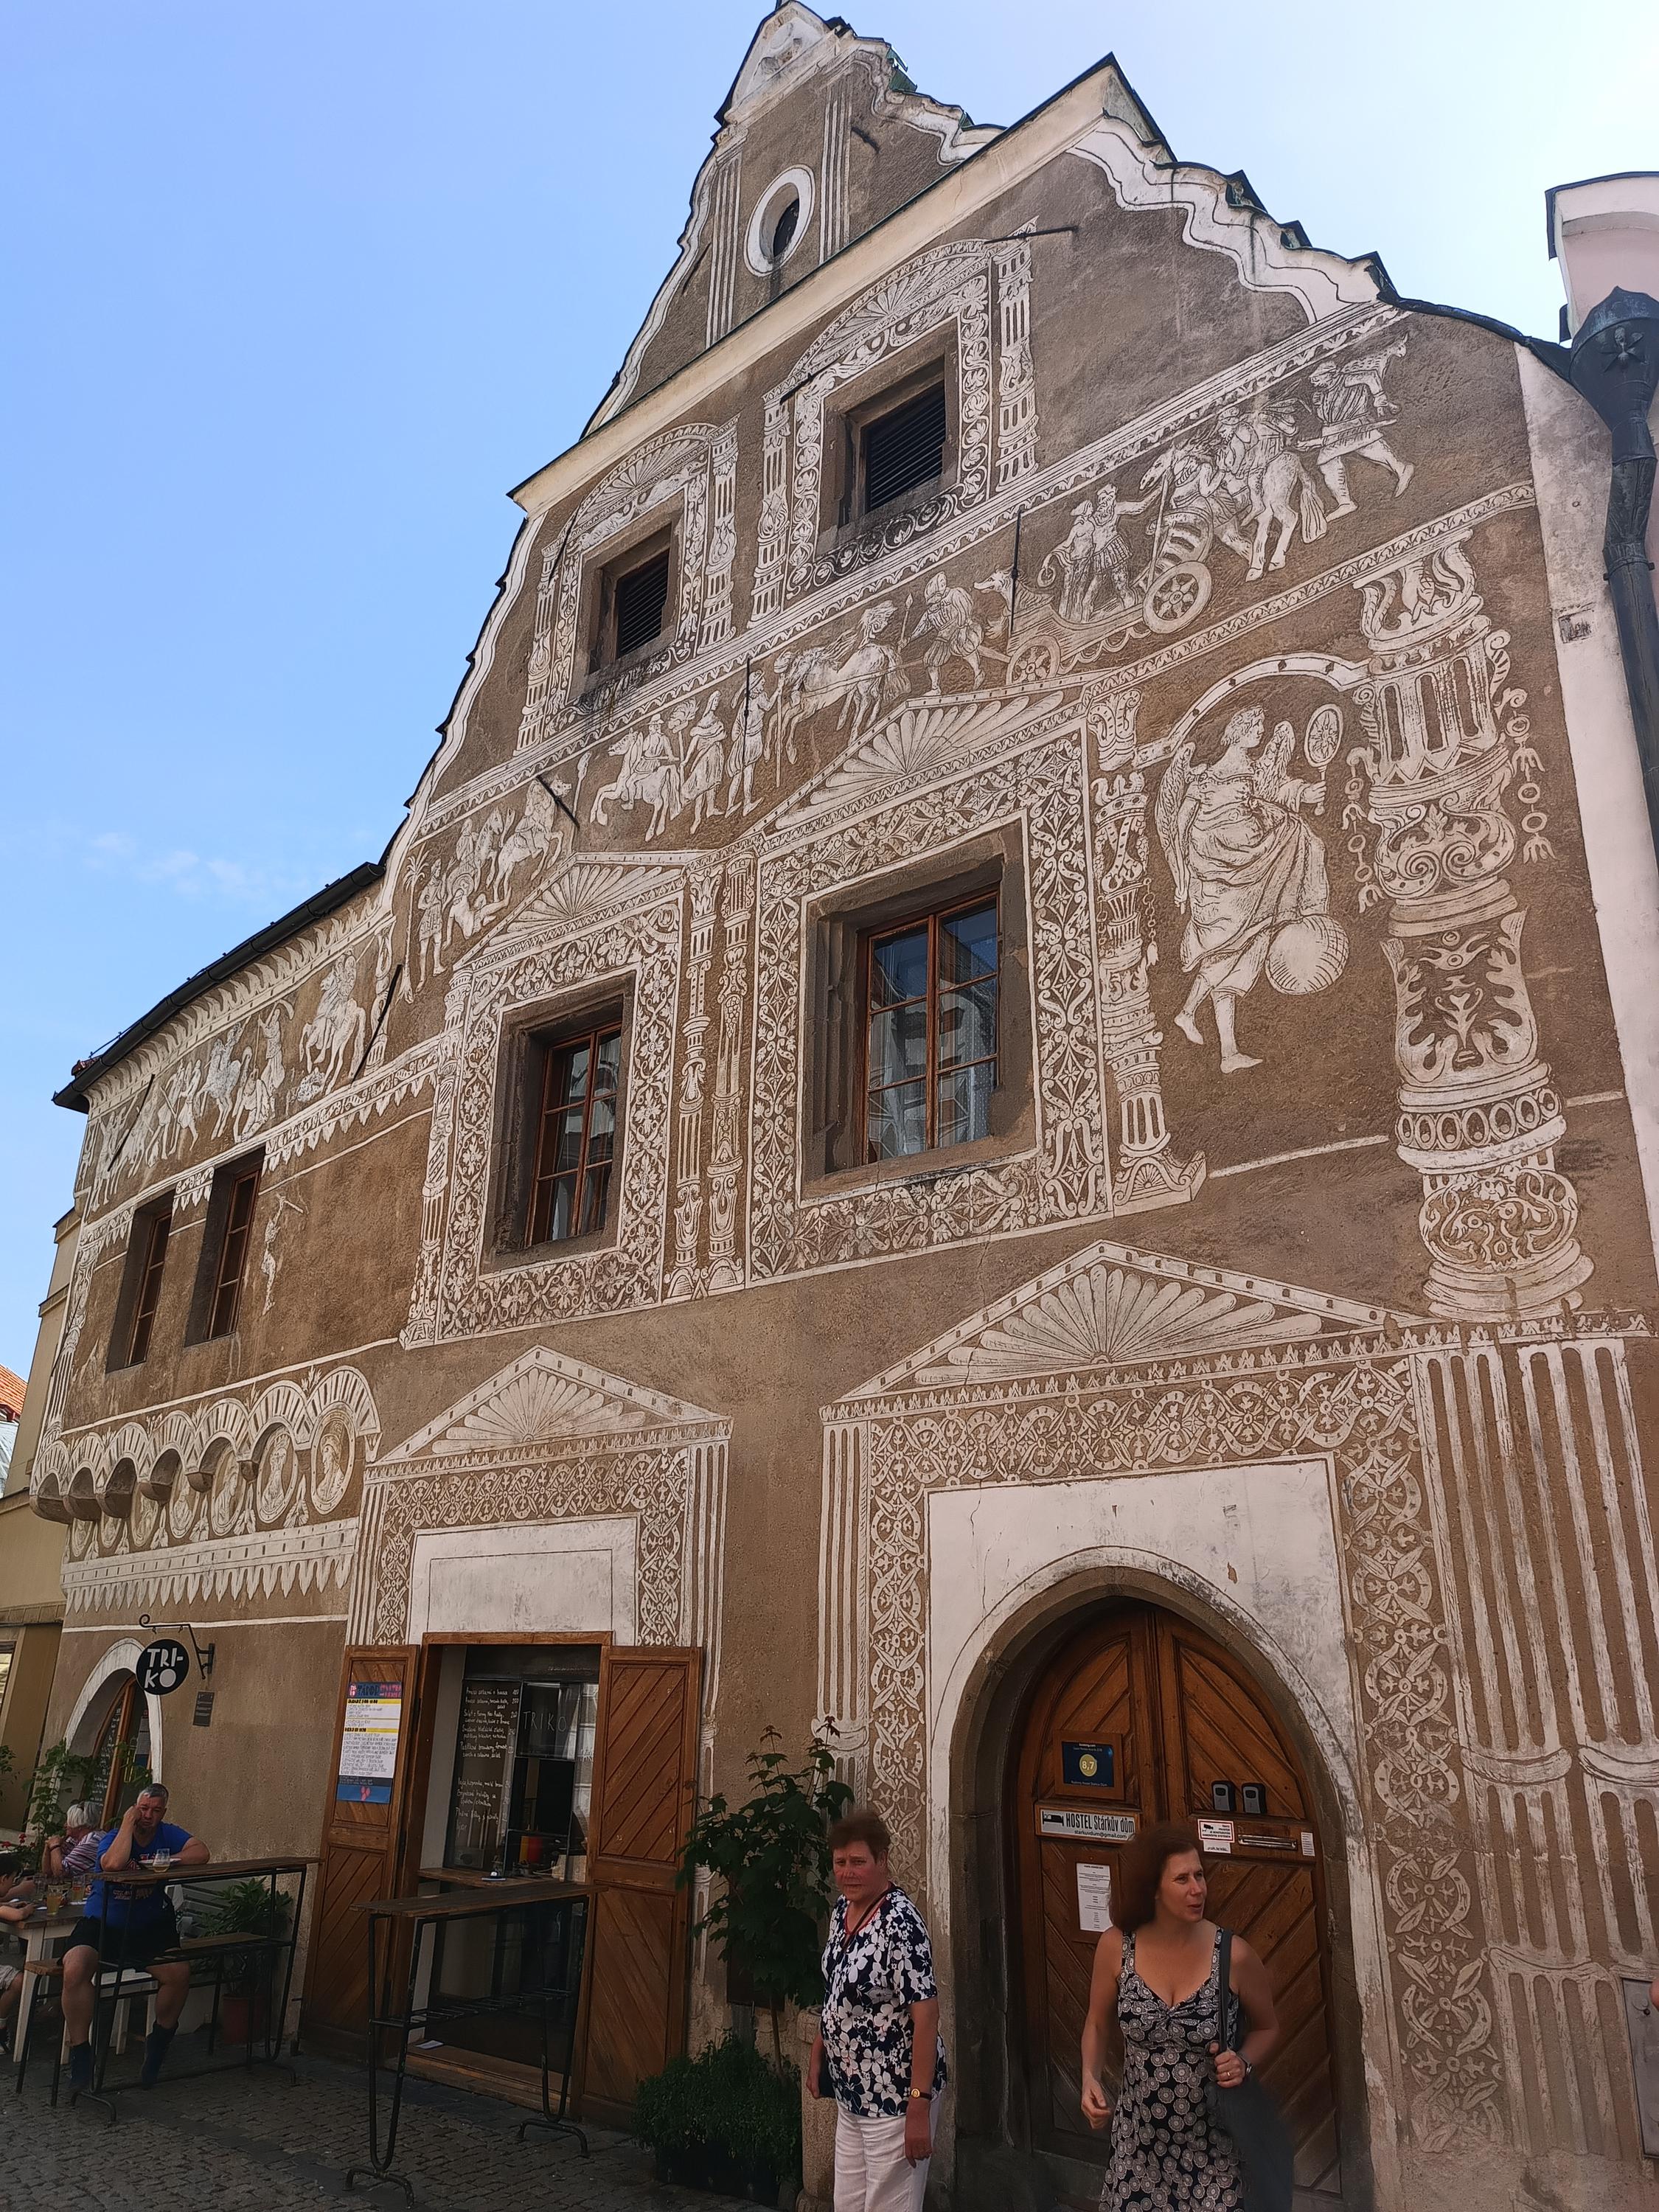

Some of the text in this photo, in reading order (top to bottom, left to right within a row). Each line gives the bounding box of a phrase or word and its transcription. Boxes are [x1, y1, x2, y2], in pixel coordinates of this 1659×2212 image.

[147, 1647, 184, 1668] TRI-
[144, 1668, 177, 1688] KO
[523, 1711, 567, 1732] TRIKO
[1082, 1761, 1094, 1770] 8,7
[1065, 1812, 1134, 1833] HOSTEL Stárkův dům
[1074, 1830, 1127, 1839] starkuvdum@gmail.com
